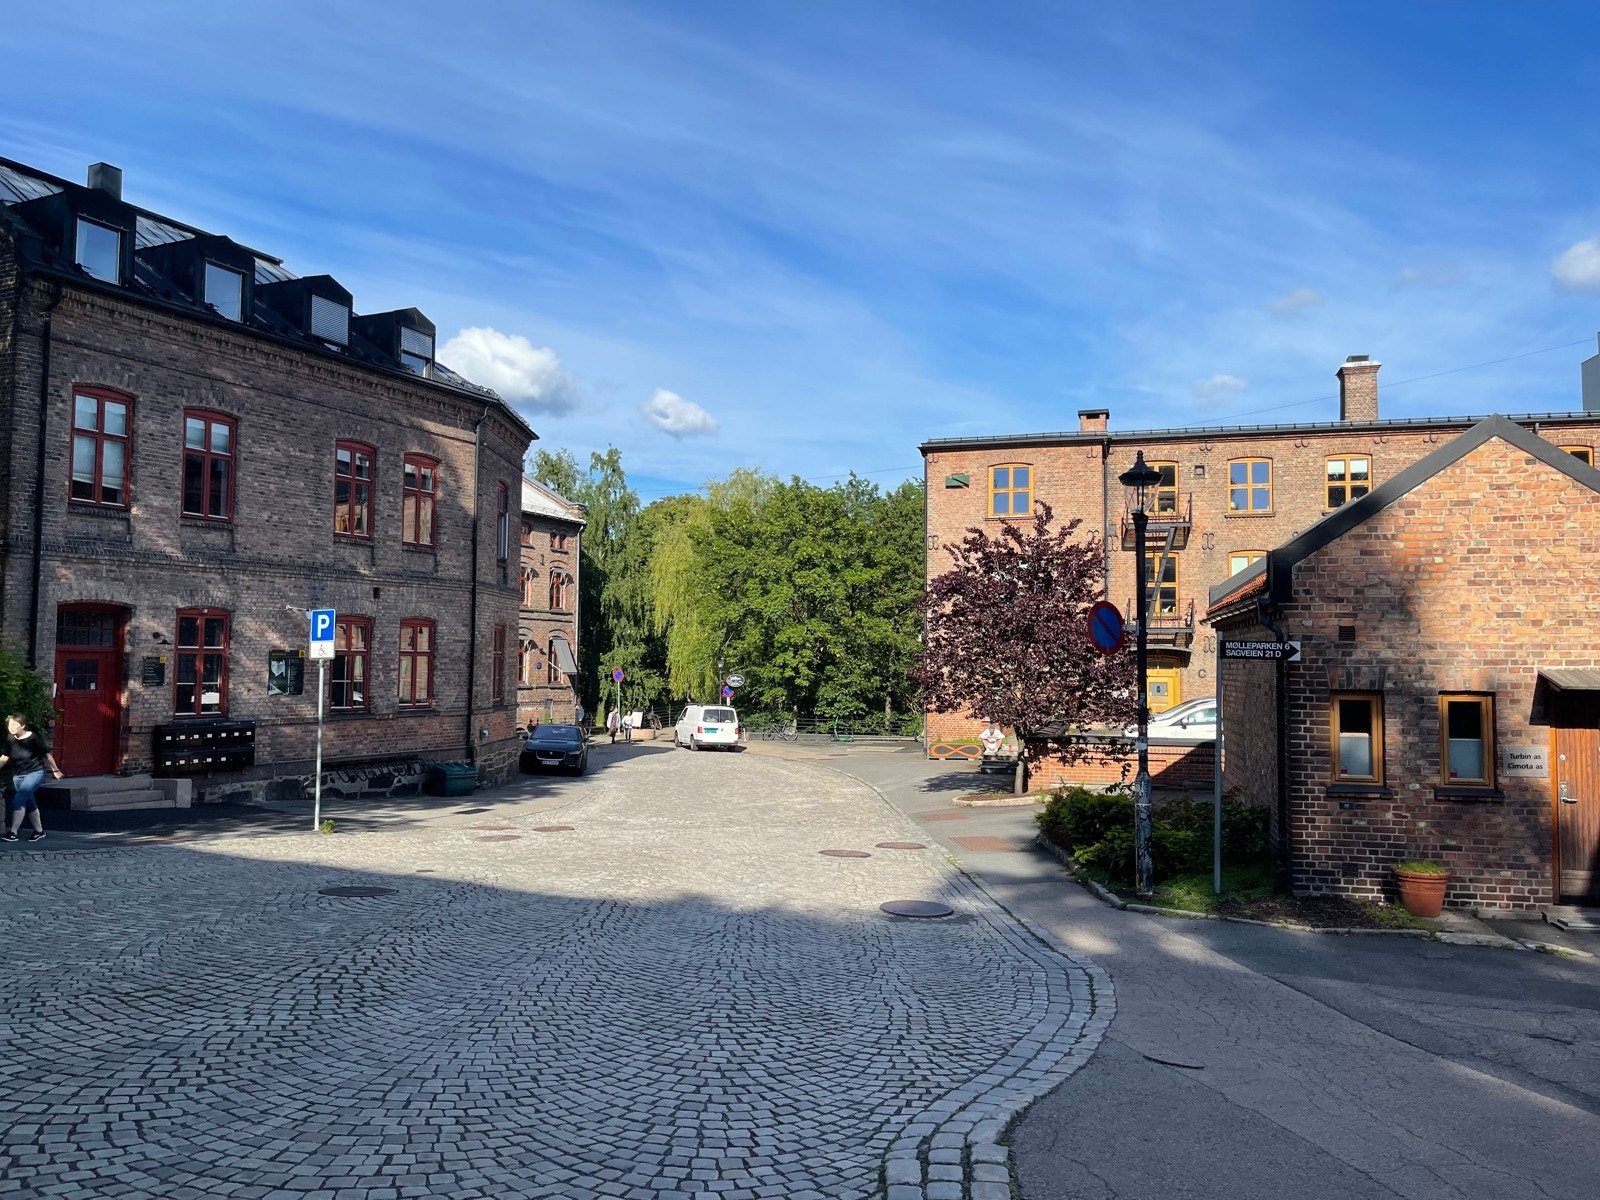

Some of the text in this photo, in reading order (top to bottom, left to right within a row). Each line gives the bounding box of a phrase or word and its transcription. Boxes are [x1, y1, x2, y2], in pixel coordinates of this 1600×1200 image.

[317, 614, 330, 638] P
[1225, 641, 1283, 650] MØLLEPARKEN
[1225, 649, 1282, 658] SAGVEIEN 21 D
[1507, 762, 1534, 770] Cimota
